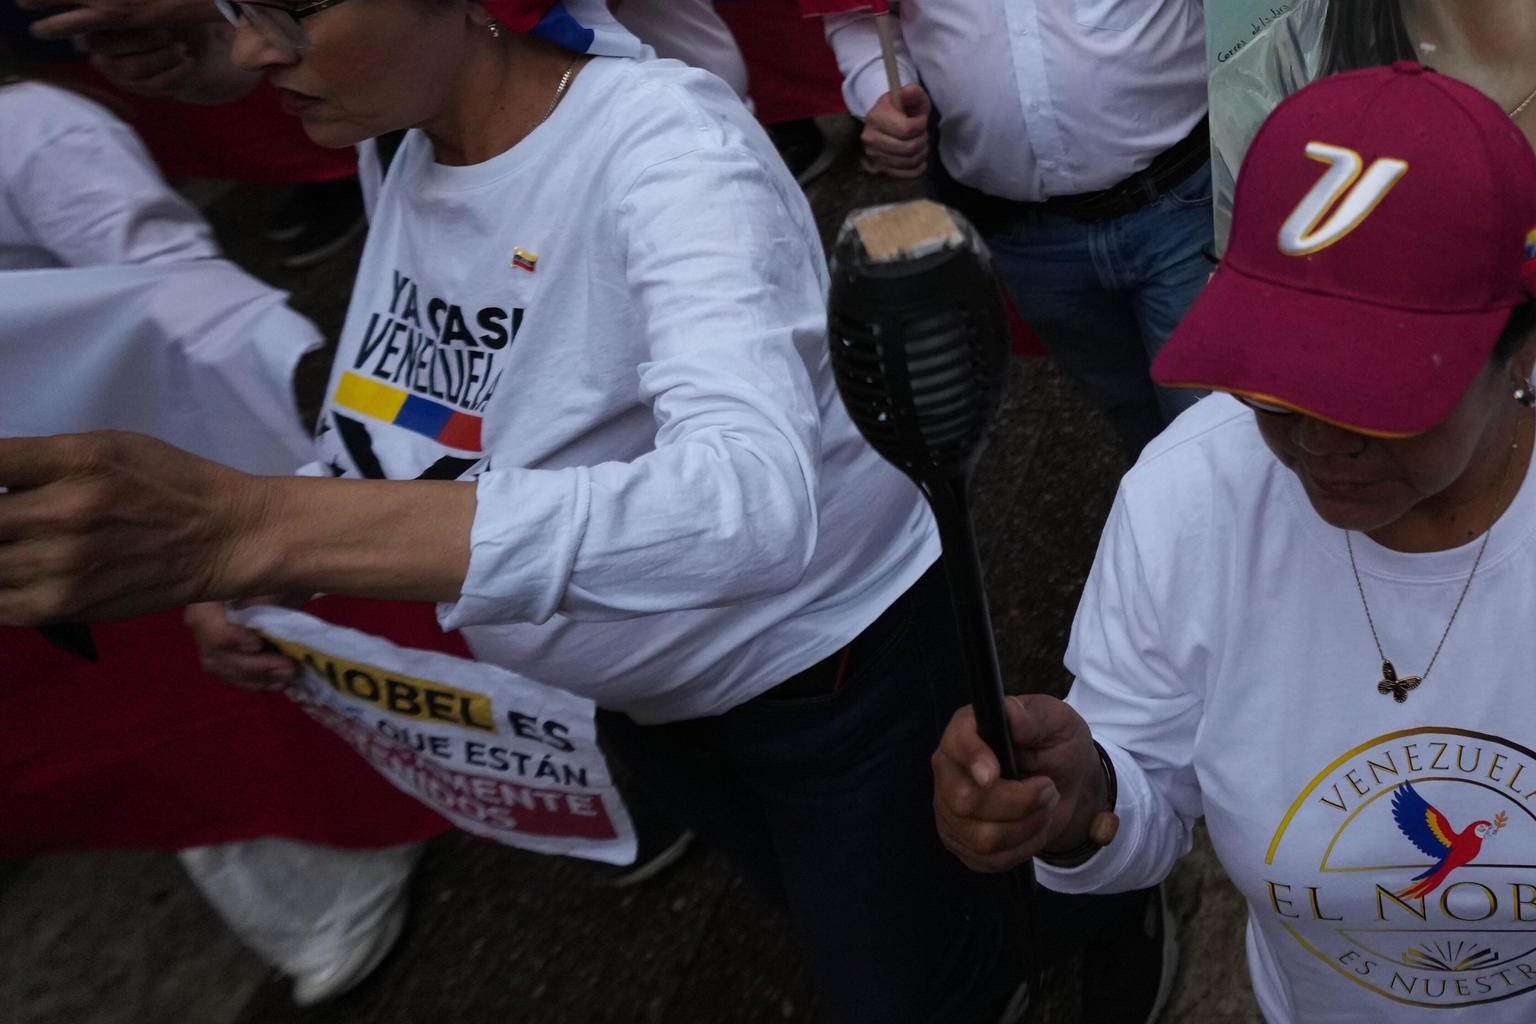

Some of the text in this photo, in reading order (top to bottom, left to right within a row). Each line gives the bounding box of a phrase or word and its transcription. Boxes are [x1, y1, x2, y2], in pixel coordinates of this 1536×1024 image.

[389, 270, 422, 329] YA
[303, 654, 496, 732] NOBEL
[507, 710, 576, 753] ES
[376, 719, 588, 788] QUE ESTÁN
[1265, 880, 1344, 922] EL
[1338, 950, 1378, 976] ES
